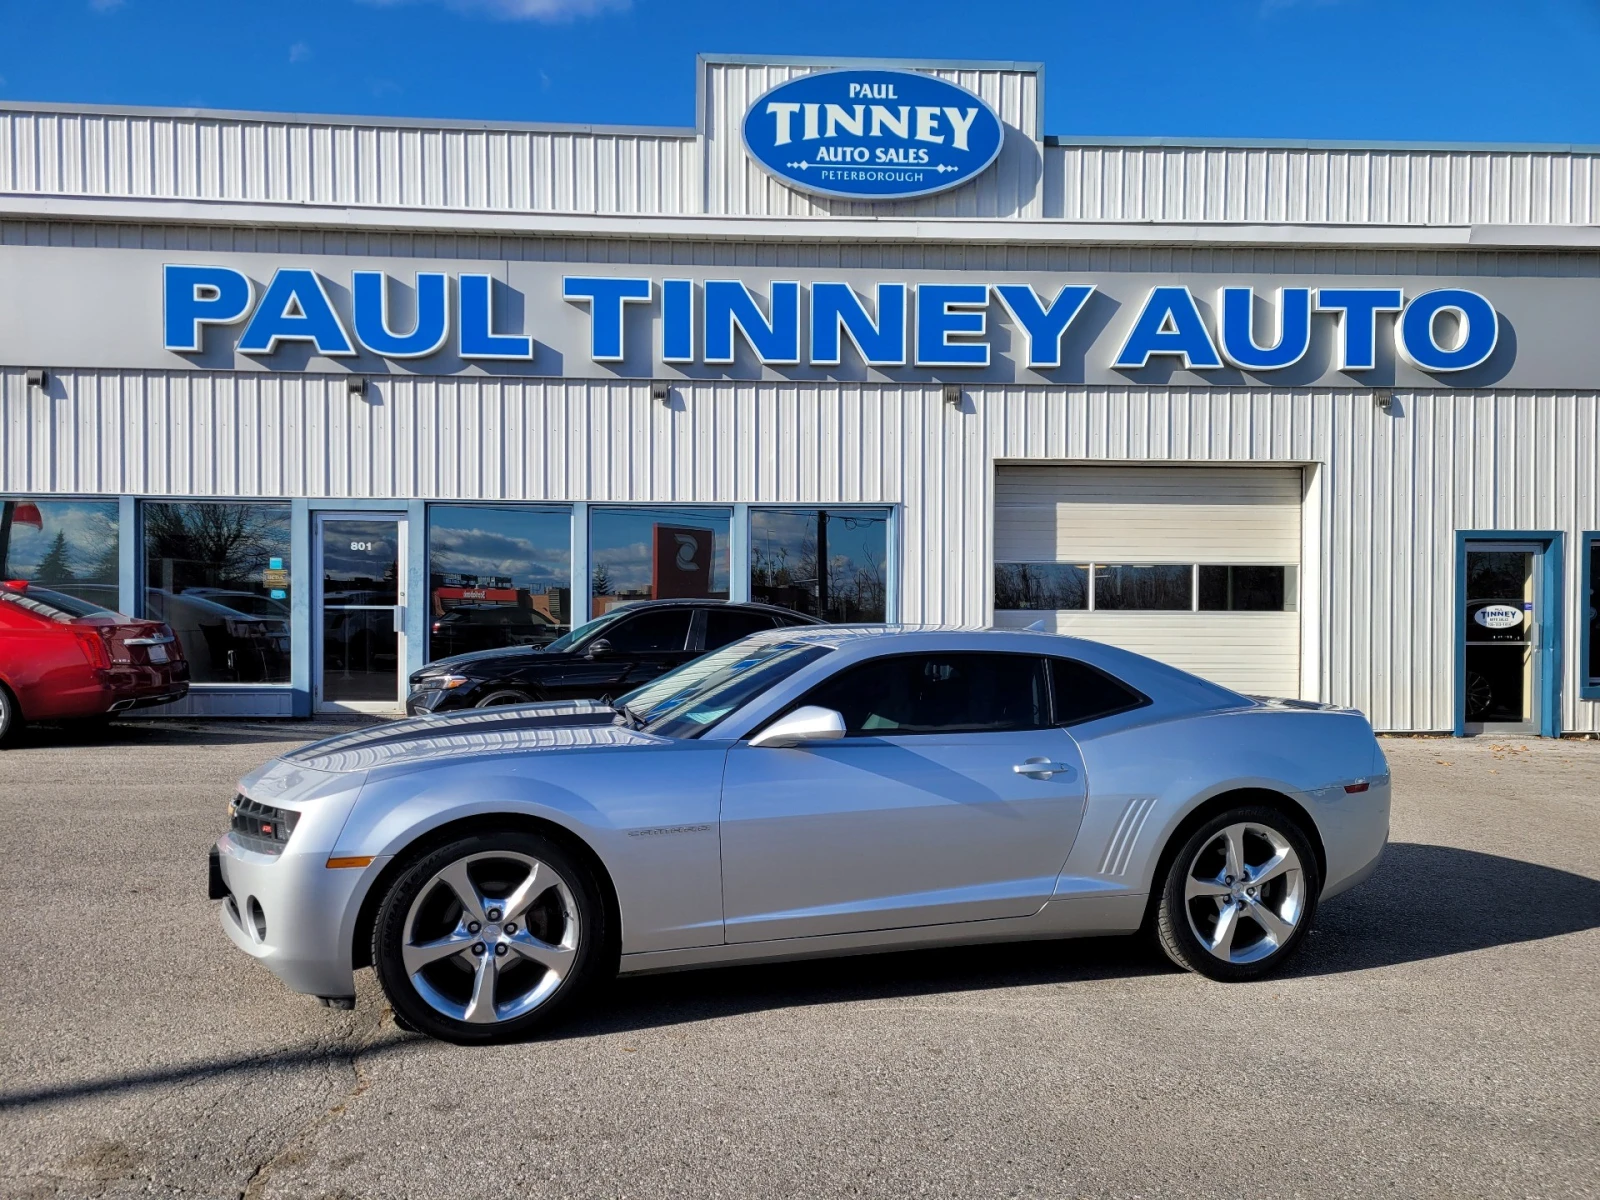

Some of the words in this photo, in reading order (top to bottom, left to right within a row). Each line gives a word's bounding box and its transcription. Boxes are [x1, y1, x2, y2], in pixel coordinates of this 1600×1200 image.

[849, 83, 898, 99] PAUL
[766, 102, 979, 152] TINNEY
[816, 146, 870, 162] AUTO
[875, 148, 929, 164] SALES
[821, 170, 923, 182] PETERBOROUGH
[163, 263, 534, 360] PAUL
[563, 275, 1097, 370] TINNEY
[1111, 285, 1499, 374] AUTO
[350, 541, 372, 551] 801
[1480, 611, 1516, 619] TINNEY
